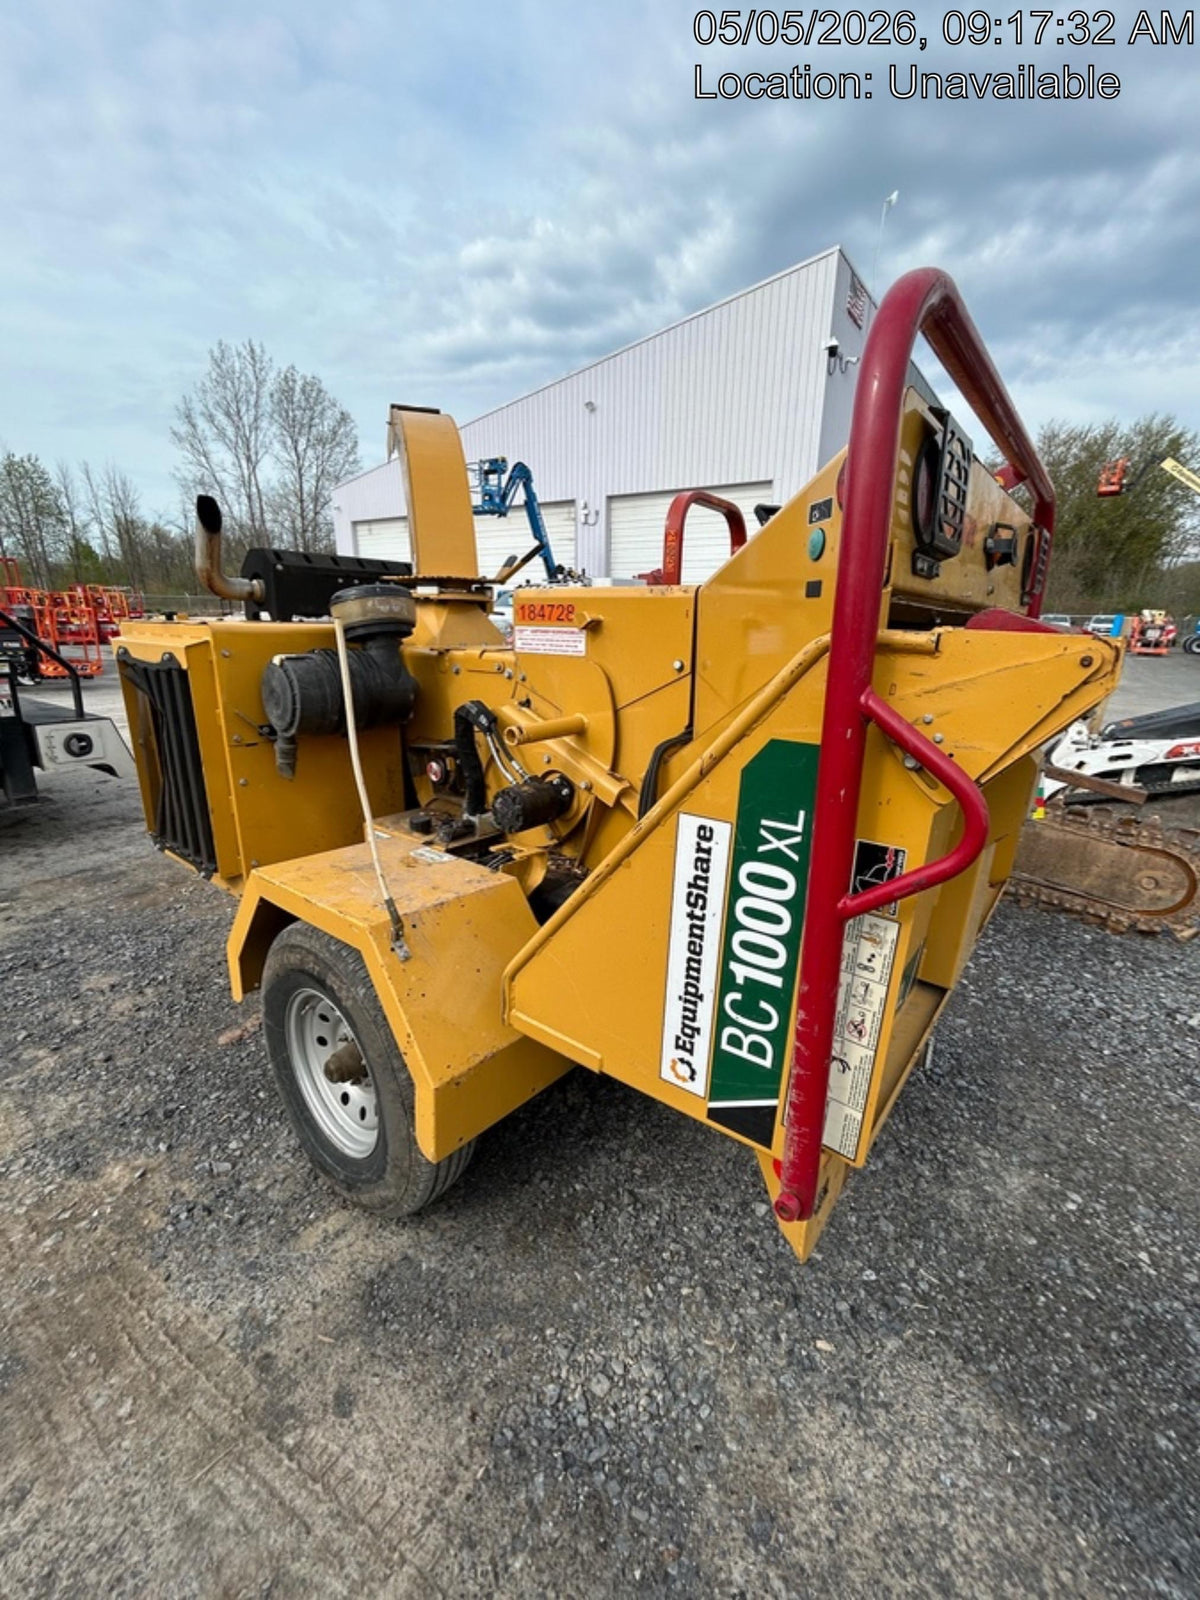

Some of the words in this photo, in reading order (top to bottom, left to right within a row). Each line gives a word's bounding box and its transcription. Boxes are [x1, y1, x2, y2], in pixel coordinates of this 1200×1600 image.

[519, 603, 575, 623] 184728
[674, 823, 714, 1057] EquipmentShare
[728, 860, 797, 989] 1000
[719, 991, 780, 1070] BC
